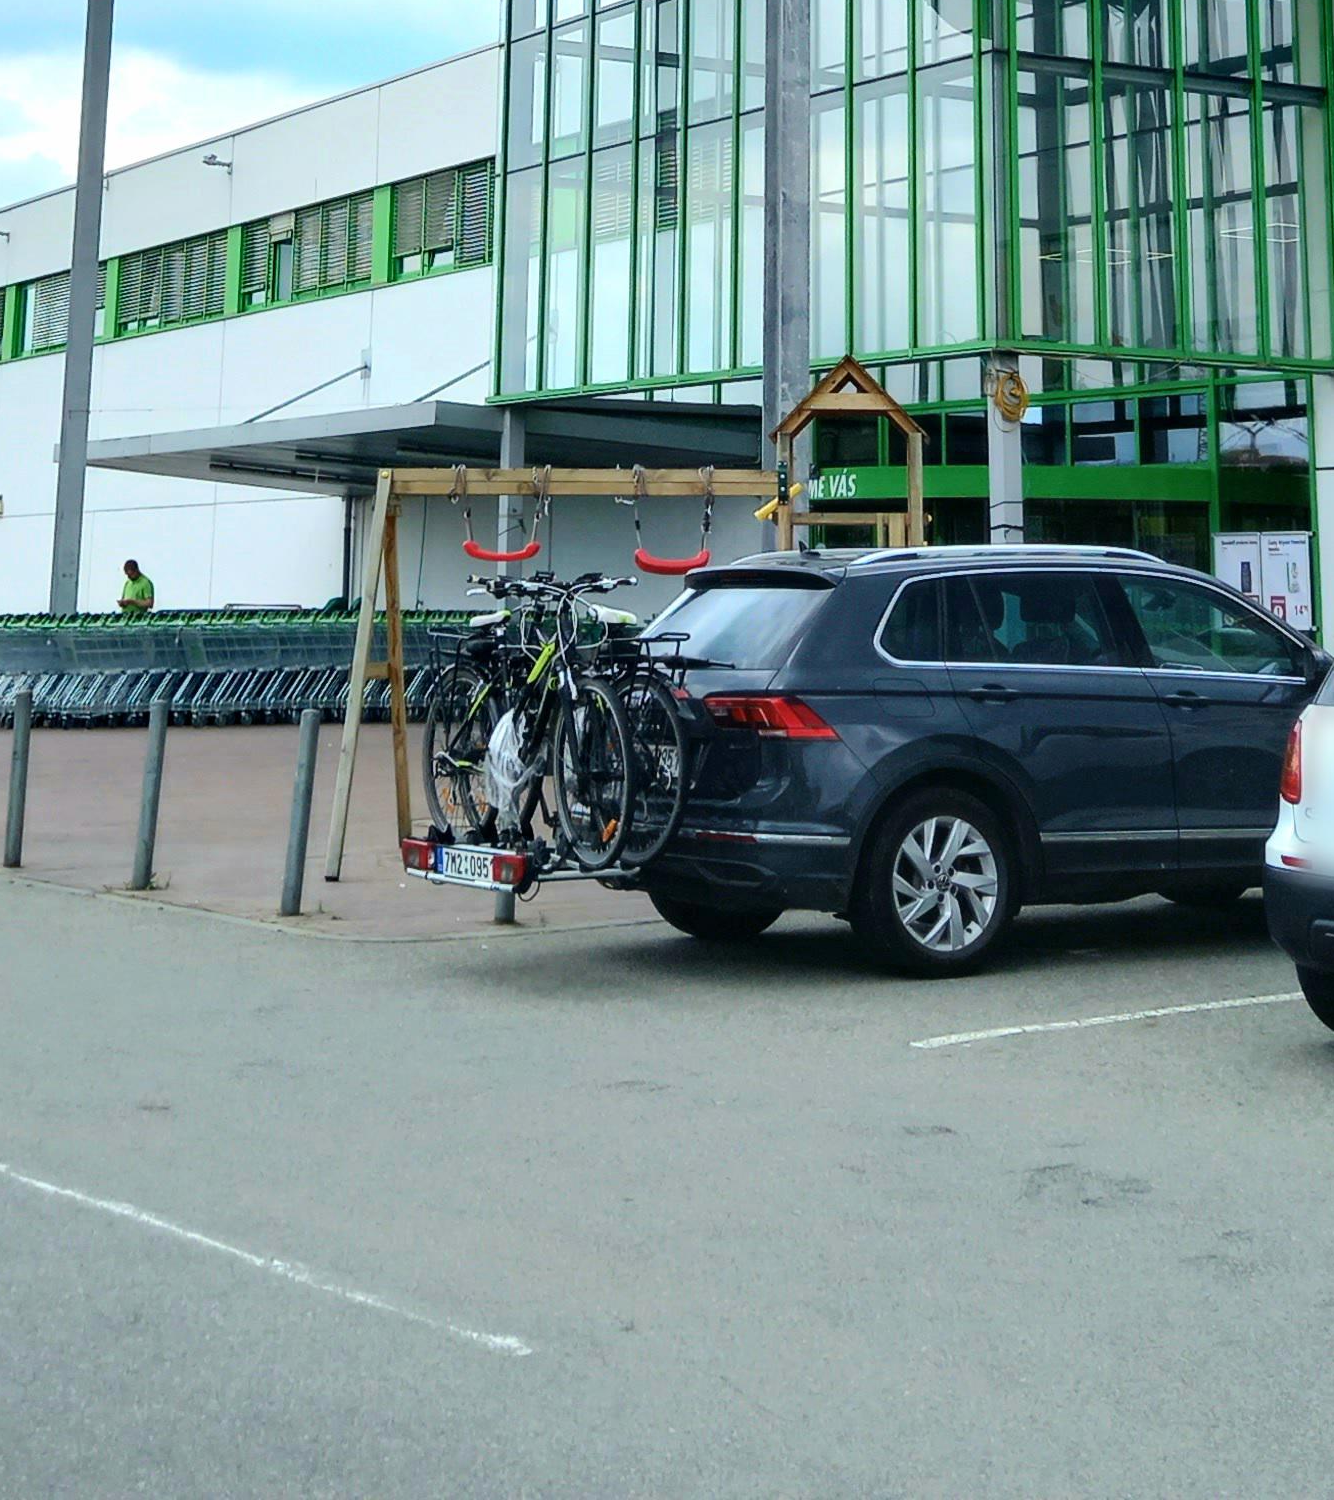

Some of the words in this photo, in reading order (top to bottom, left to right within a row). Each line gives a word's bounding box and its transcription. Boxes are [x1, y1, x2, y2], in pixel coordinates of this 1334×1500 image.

[829, 468, 857, 498] VÁS
[444, 851, 463, 874] 7M2
[470, 855, 493, 878] 095
